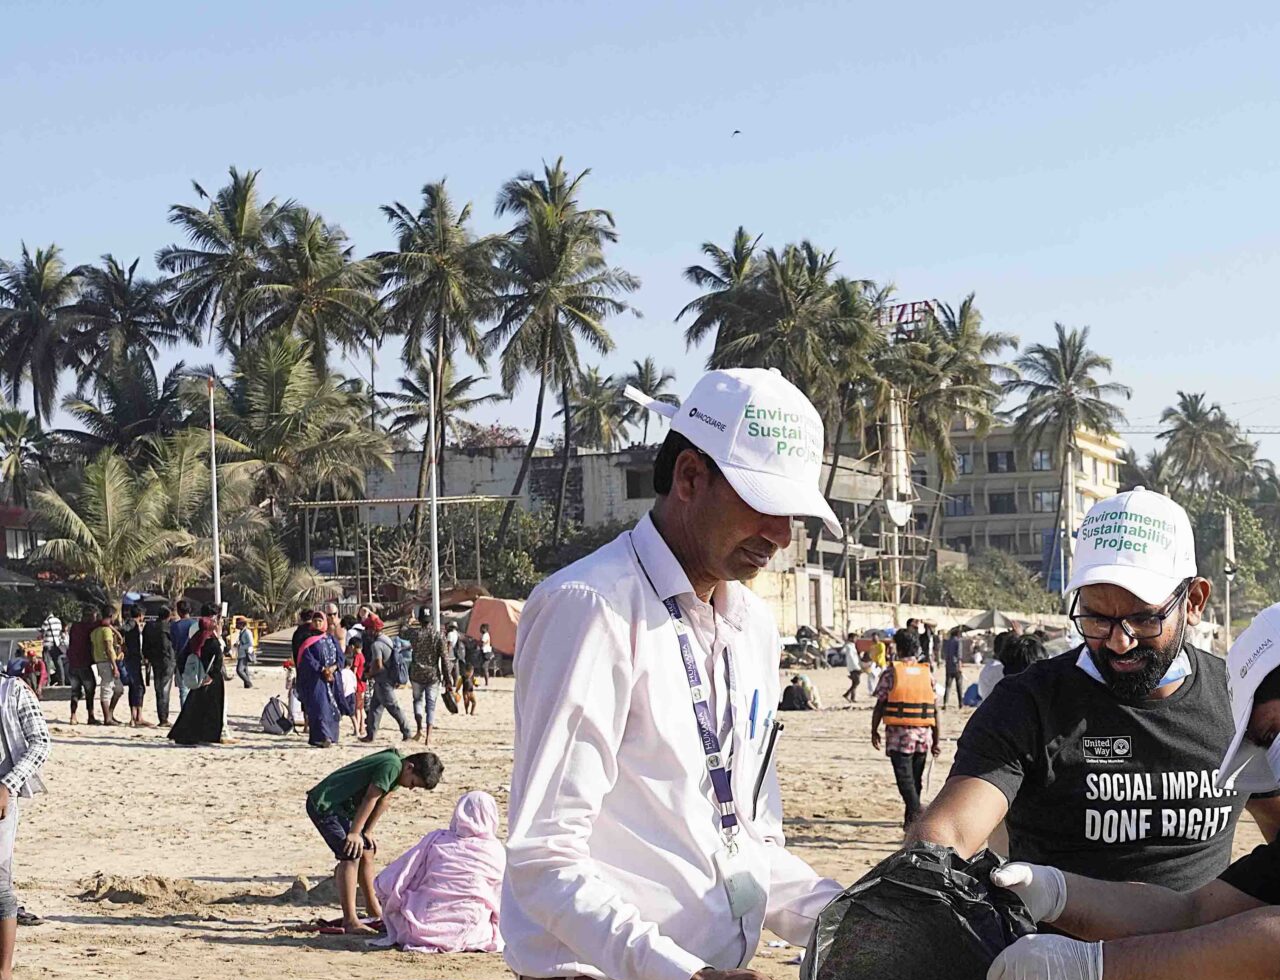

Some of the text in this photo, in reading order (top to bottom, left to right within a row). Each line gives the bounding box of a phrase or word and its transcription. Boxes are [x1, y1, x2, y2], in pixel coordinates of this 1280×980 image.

[748, 422, 802, 440] Sustai
[1082, 521, 1172, 550] Sustainability
[1095, 536, 1147, 554] Project
[682, 644, 695, 683] HUMANA
[699, 712, 712, 750] HUMANA
[1084, 739, 1110, 747] United
[1094, 747, 1110, 756] Way
[1086, 772, 1157, 801] SOCIAL
[1161, 806, 1233, 841] RIGHT
